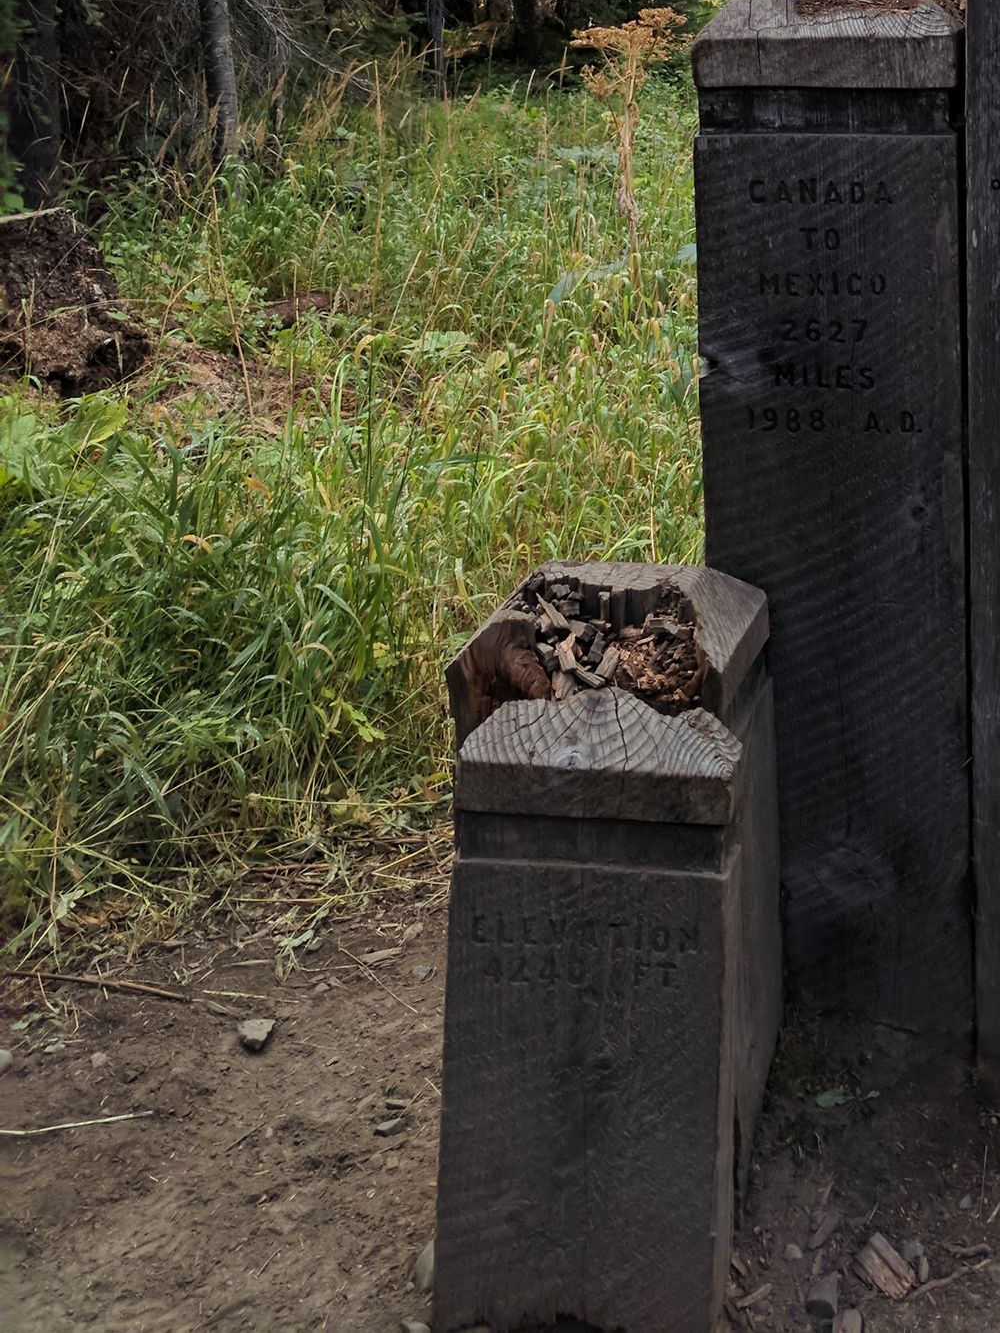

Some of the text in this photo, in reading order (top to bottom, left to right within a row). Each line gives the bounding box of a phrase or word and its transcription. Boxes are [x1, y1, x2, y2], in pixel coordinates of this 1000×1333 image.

[748, 177, 895, 206] CANADA
[799, 226, 842, 252] TO
[758, 271, 887, 298] MEXICO
[780, 318, 869, 344] 2627
[774, 364, 876, 391] MILES
[747, 405, 827, 434] 1988
